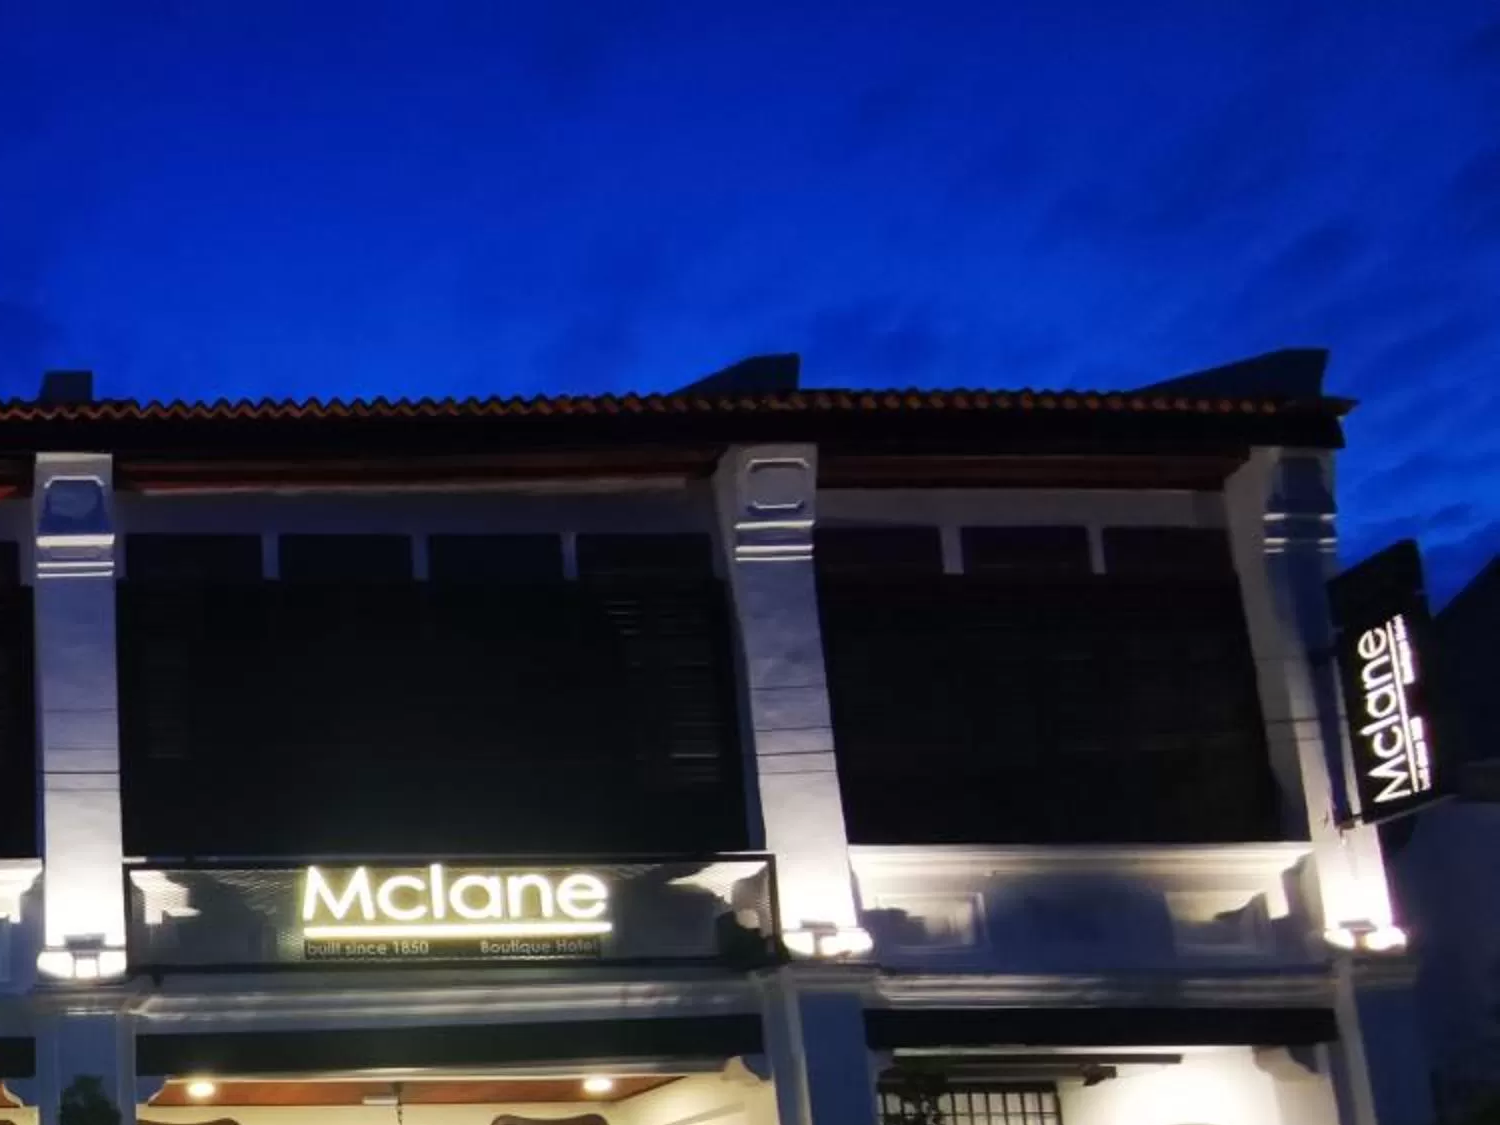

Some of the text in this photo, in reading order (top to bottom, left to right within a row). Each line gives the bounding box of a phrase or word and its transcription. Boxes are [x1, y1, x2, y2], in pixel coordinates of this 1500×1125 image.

[1357, 625, 1412, 803] Mclane
[302, 863, 609, 921] Mclane
[392, 939, 430, 955] 1850
[480, 938, 599, 955] Boutique Hotel
